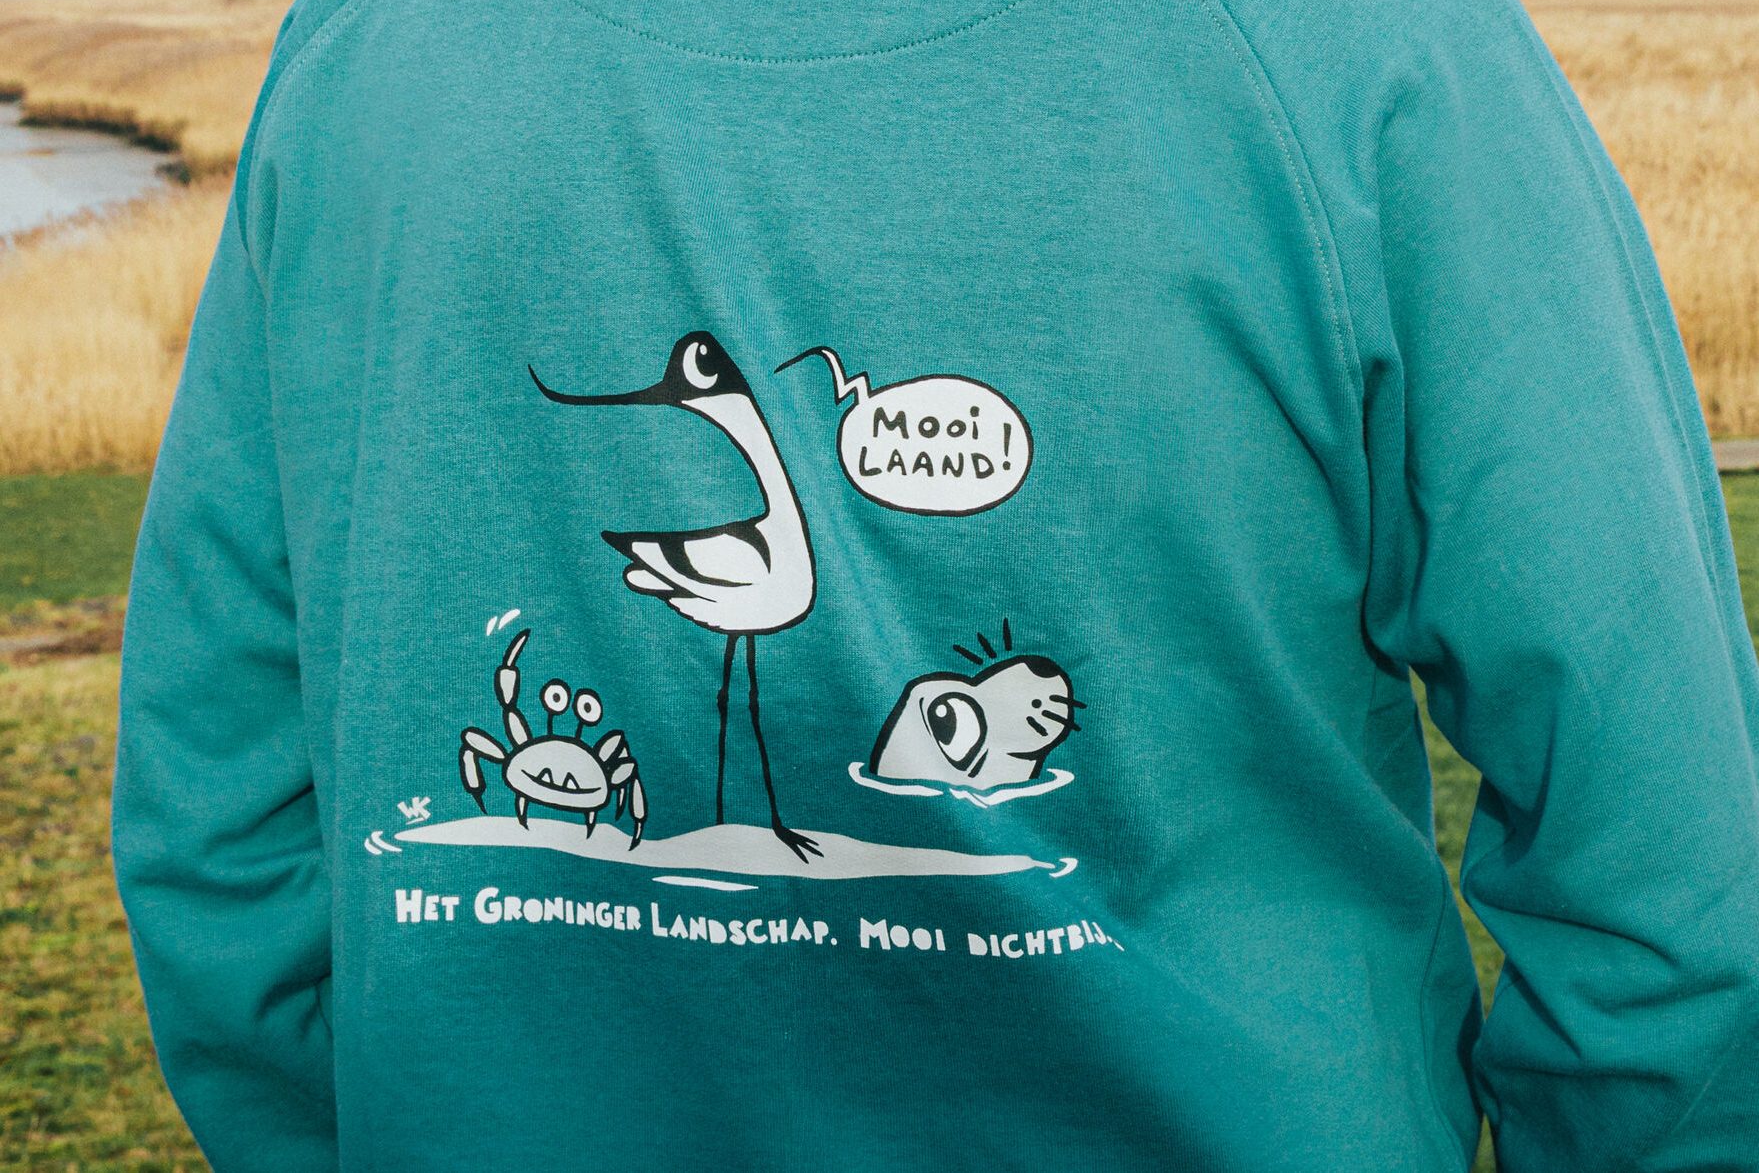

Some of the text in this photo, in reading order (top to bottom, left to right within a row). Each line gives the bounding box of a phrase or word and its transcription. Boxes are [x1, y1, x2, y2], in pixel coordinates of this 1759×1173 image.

[395, 889, 460, 923] HET
[474, 887, 642, 931] GRONINGER
[651, 902, 838, 946] LANDSCHAP.
[860, 917, 946, 951] MOOI
